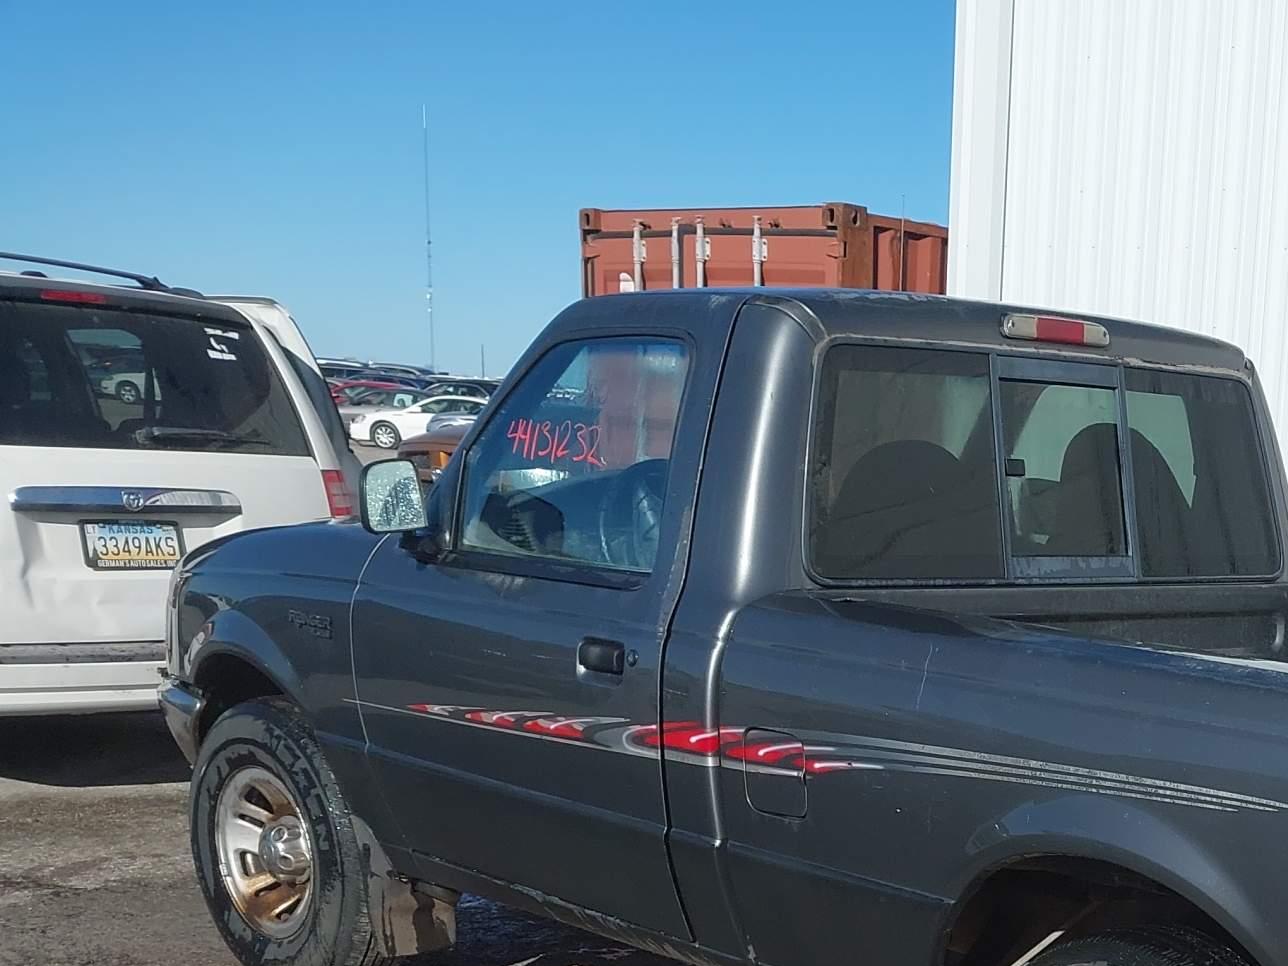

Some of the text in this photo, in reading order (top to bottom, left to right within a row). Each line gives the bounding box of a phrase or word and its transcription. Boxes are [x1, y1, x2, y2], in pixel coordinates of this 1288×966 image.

[507, 419, 606, 467] 44131232
[108, 525, 153, 534] KANSAS
[97, 536, 177, 557] 3349AKS
